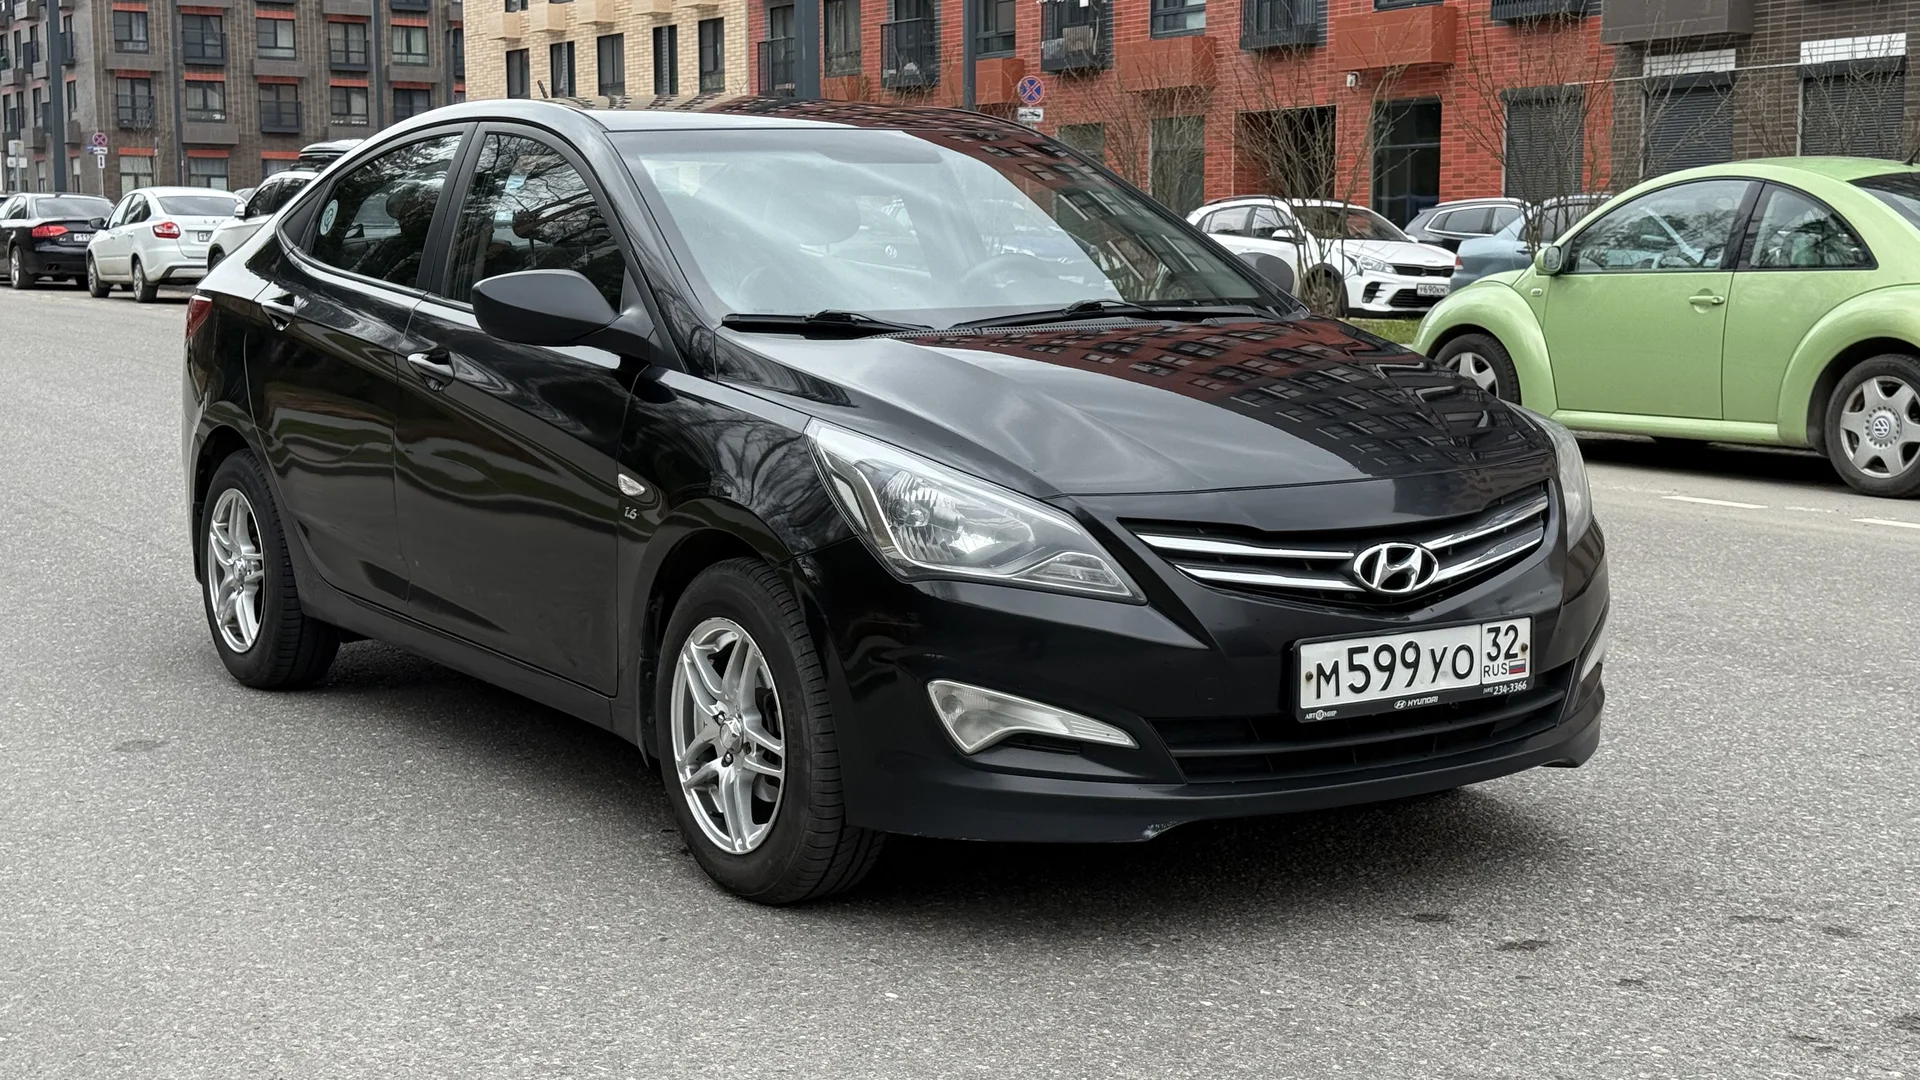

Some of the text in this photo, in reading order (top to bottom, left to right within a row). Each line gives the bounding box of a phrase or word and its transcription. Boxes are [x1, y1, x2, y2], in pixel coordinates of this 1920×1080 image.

[1486, 624, 1519, 661] 32
[1483, 661, 1508, 678] RUS
[1493, 680, 1527, 696] 234-3366
[1407, 695, 1439, 707] HYUNDAI
